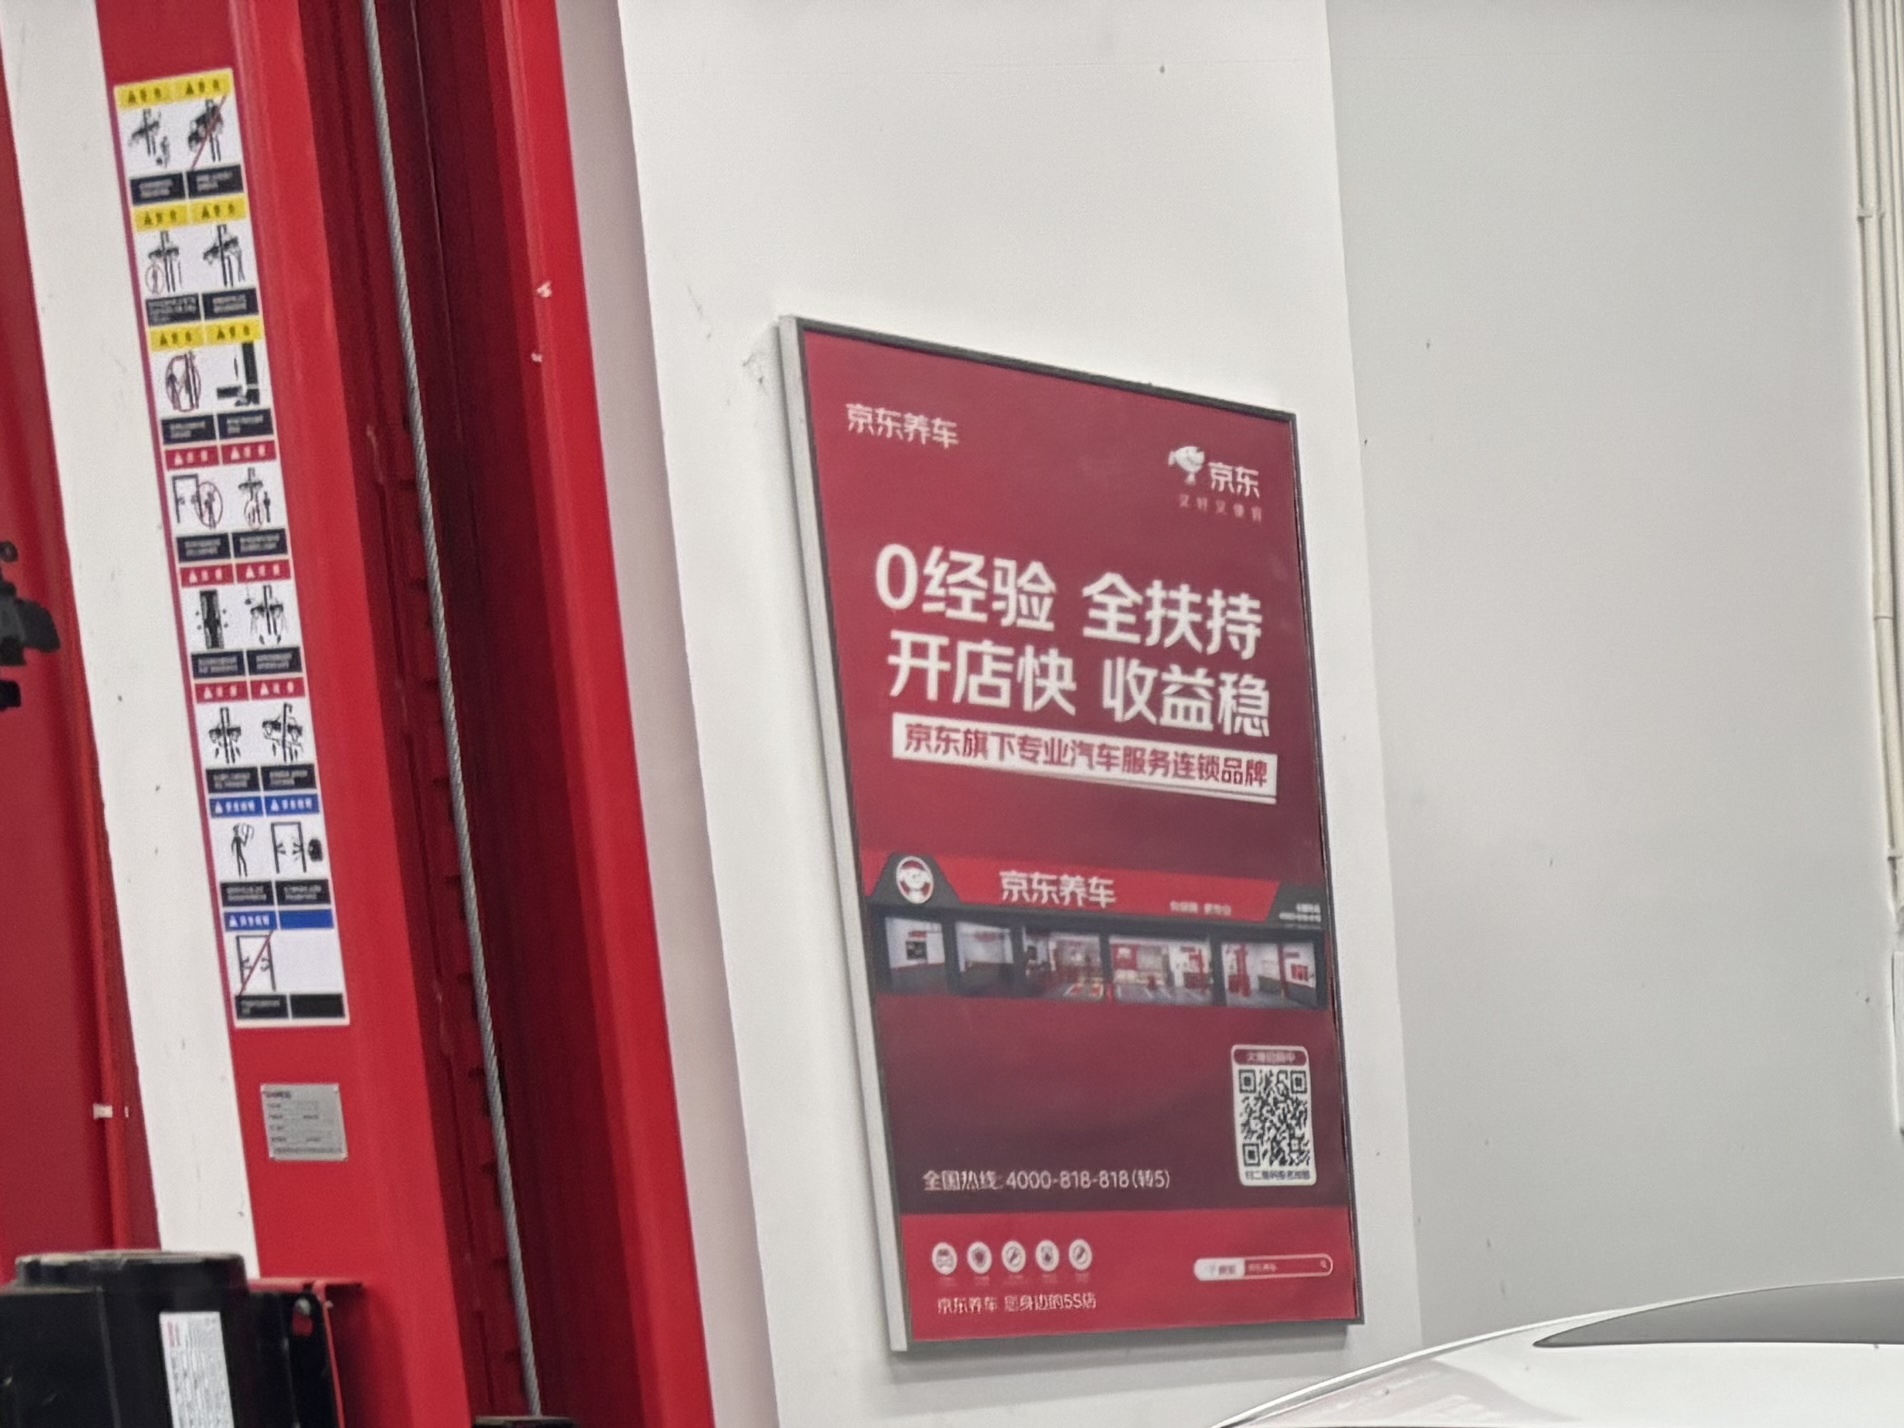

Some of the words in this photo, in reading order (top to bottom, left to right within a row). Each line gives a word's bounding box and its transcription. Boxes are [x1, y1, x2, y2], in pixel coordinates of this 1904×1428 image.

[845, 402, 960, 450] 京东养车
[1207, 461, 1261, 498] 京东
[875, 543, 1057, 632] 0经验
[1081, 571, 1263, 660] 全扶持
[887, 629, 1077, 717] 开店快
[1101, 655, 1271, 738] 收益稳
[903, 721, 1269, 789] 京东旗下专业汽车服务连锁品牌
[998, 870, 1117, 910] 京东养车
